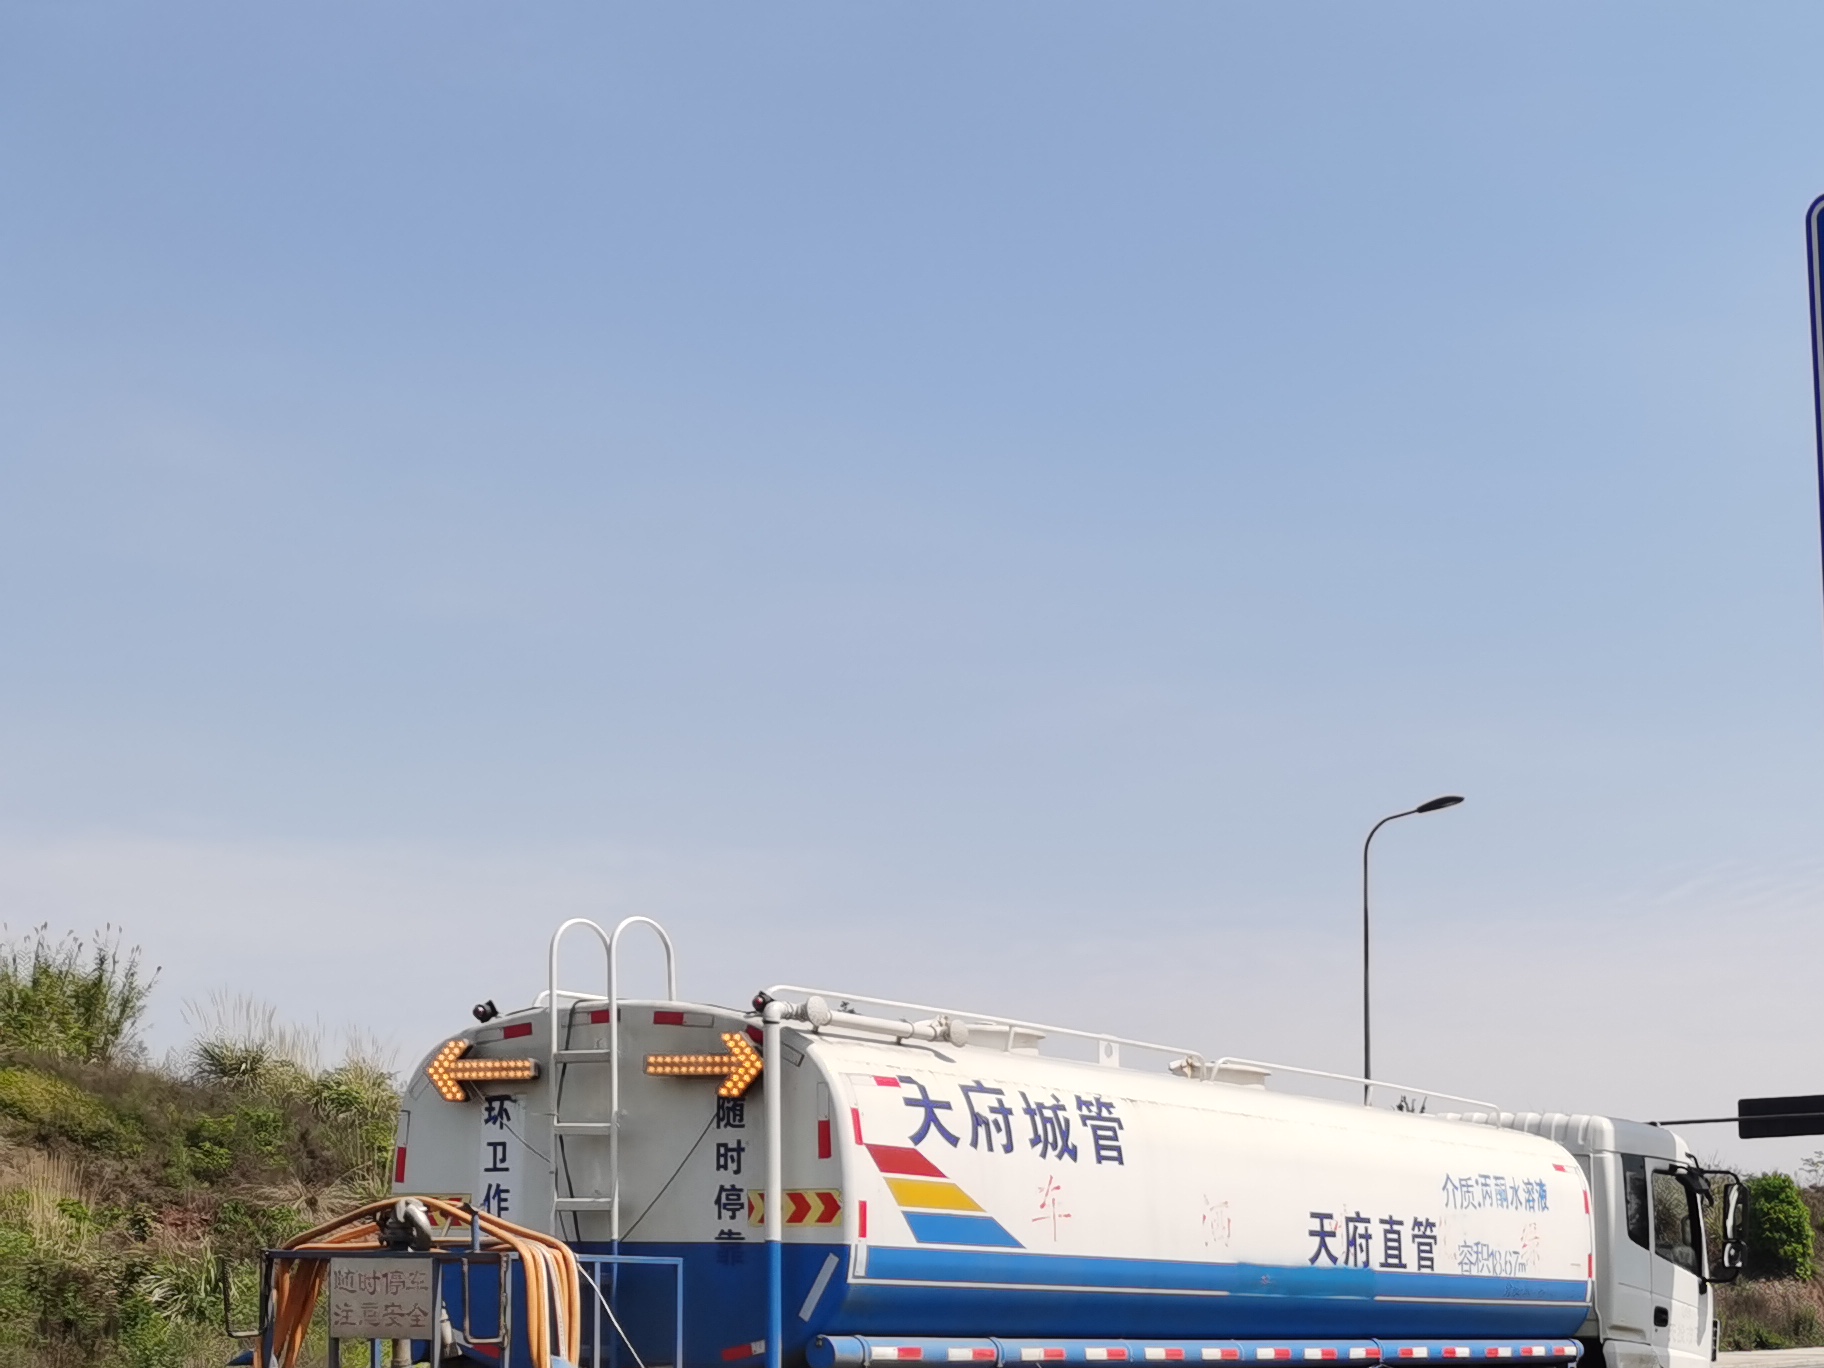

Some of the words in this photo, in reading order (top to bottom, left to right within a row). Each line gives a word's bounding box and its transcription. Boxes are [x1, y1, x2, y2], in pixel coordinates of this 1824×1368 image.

[896, 1074, 1125, 1166] 天府城管
[1308, 1211, 1438, 1271] 天府直管
